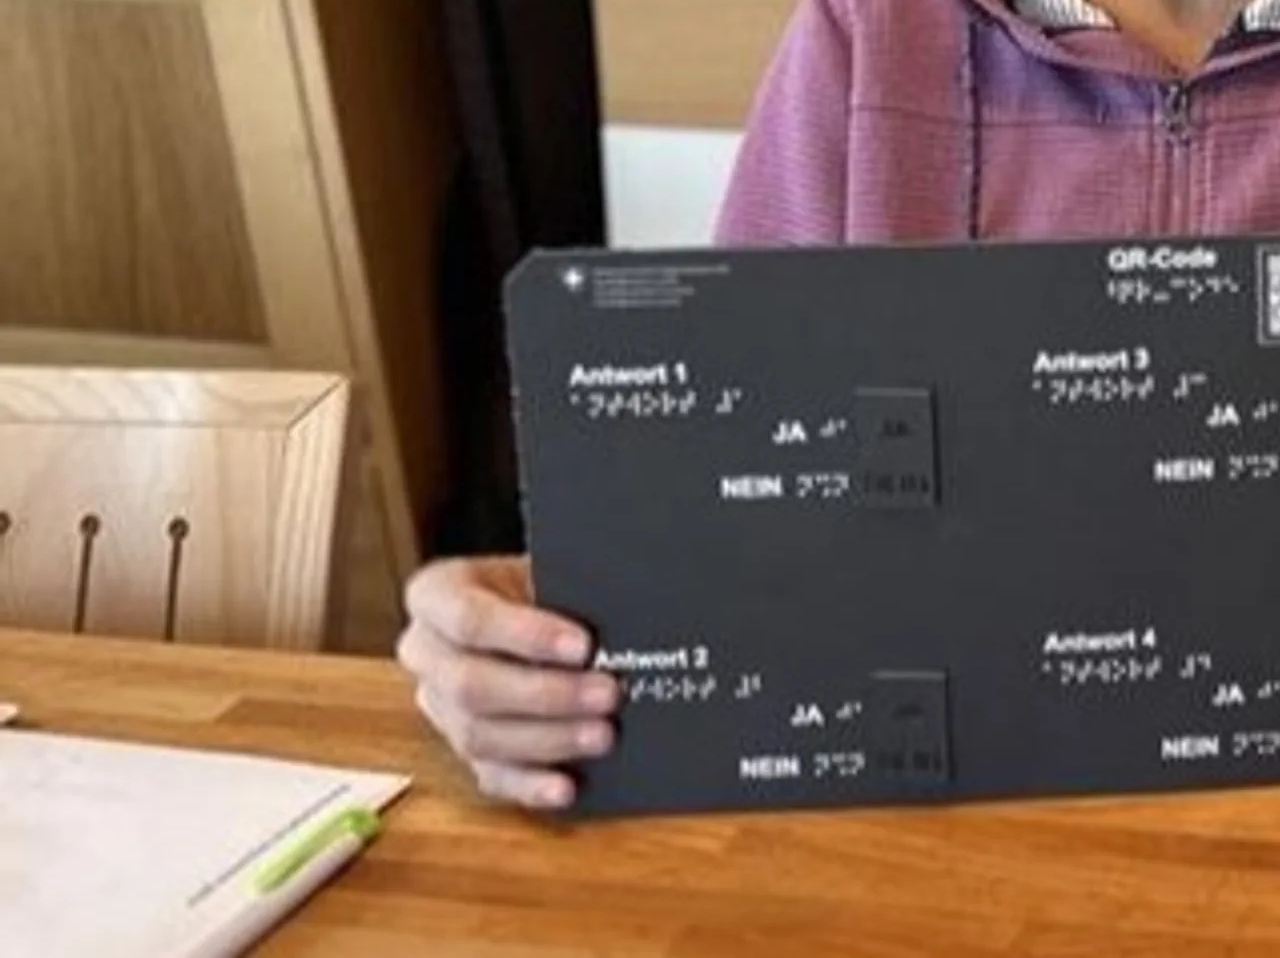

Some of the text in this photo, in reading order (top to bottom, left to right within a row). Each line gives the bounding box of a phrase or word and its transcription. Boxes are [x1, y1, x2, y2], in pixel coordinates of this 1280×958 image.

[1107, 246, 1217, 271] QR-Code
[1033, 347, 1150, 373] Antwort 3
[569, 361, 689, 387] Antwort 1
[1206, 403, 1240, 427] JA
[772, 420, 808, 444] JA
[1154, 458, 1215, 482] NEIN
[720, 475, 783, 499] NEIN
[1043, 627, 1156, 653] Antwort 4
[594, 645, 709, 670] Antwort 2
[1212, 683, 1245, 707] JA
[790, 704, 825, 727] JA
[1161, 735, 1219, 759] NEIN
[739, 756, 800, 779] NEIN
